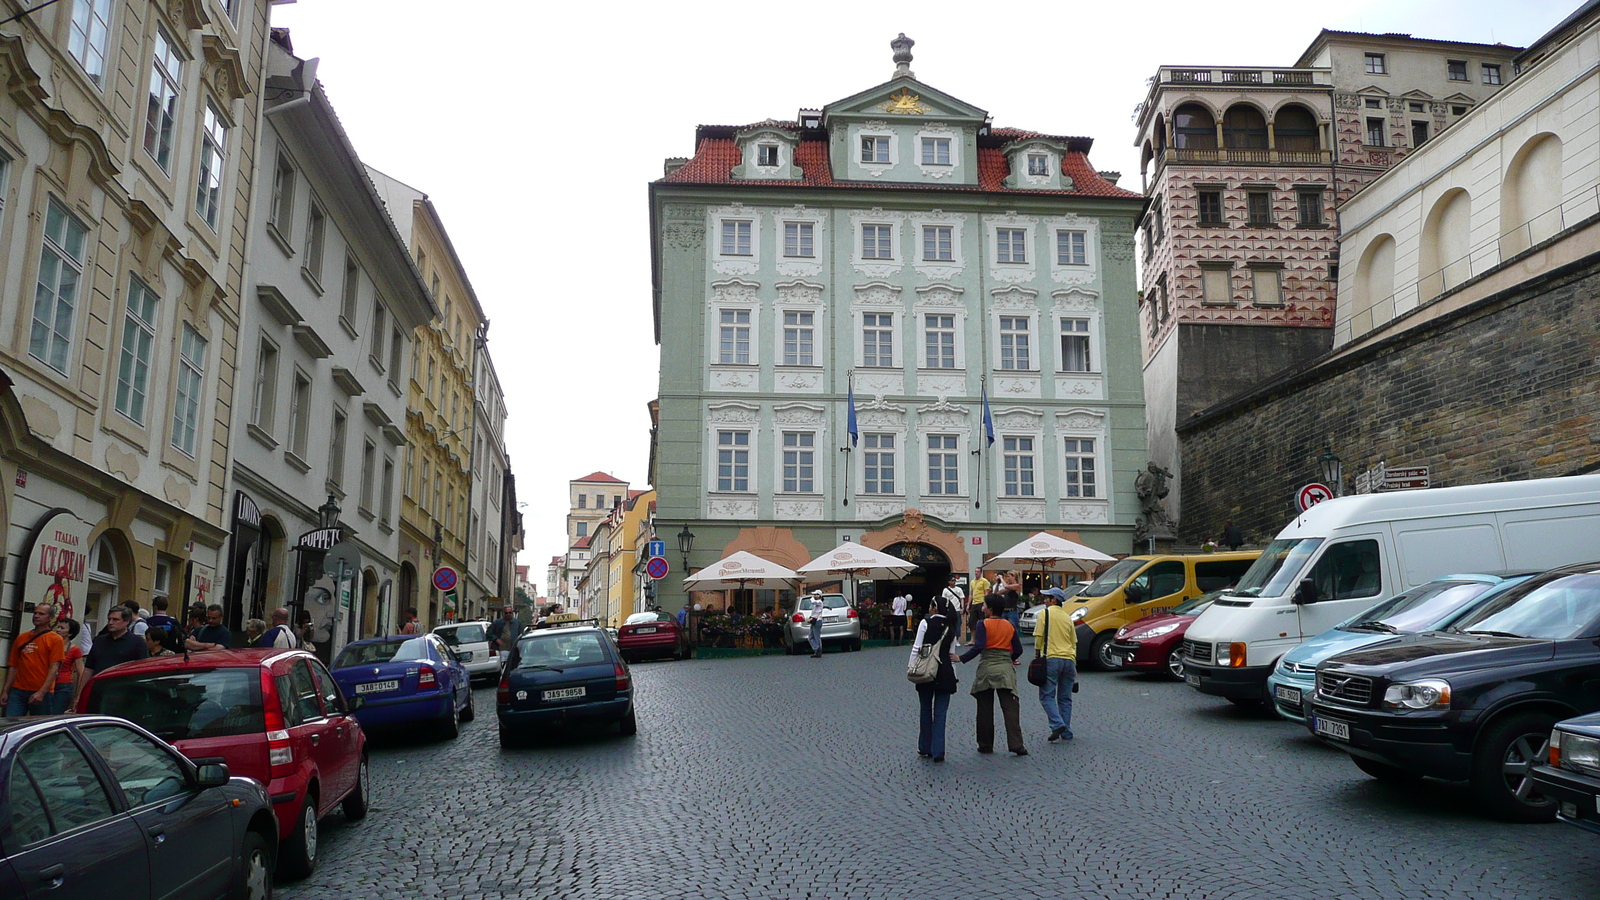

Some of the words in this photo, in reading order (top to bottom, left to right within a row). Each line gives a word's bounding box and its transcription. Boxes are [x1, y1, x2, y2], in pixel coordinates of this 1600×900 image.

[54, 530, 80, 546] ITALIAN
[38, 543, 58, 577] ICE
[57, 548, 86, 582] CREAM
[552, 613, 572, 621] TAXI
[361, 683, 373, 692] 3A8
[378, 681, 395, 690] 0148
[547, 690, 561, 699] 3A9
[564, 688, 583, 697] 9858
[1317, 717, 1328, 732] 7A7
[1331, 719, 1347, 737] 7391
